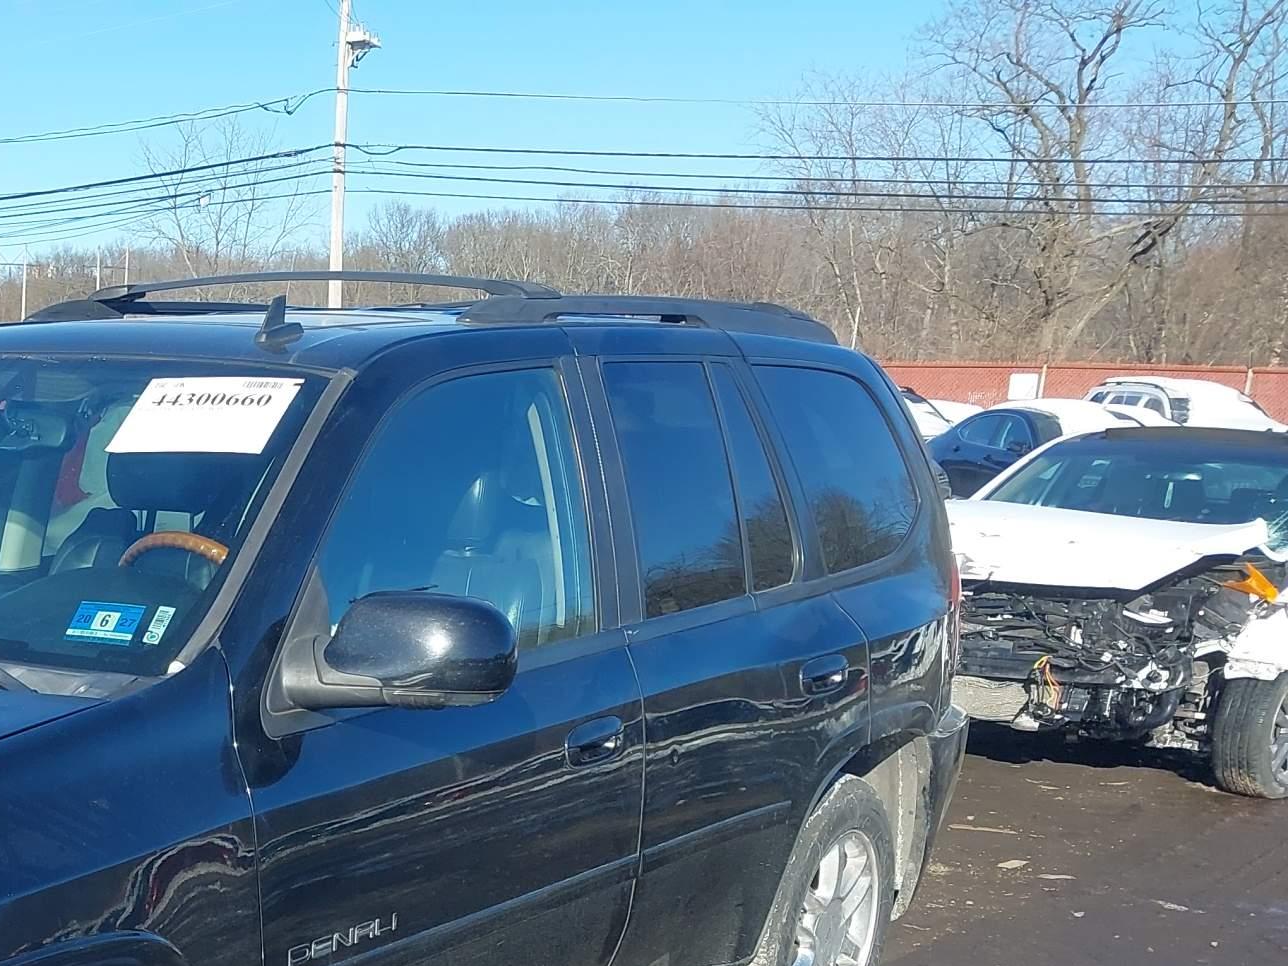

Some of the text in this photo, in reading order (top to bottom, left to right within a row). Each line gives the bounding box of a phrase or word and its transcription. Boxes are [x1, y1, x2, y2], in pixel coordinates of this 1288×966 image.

[151, 392, 273, 407] 44300660
[76, 614, 136, 629] 20 6 27
[287, 912, 398, 966] DENALI
